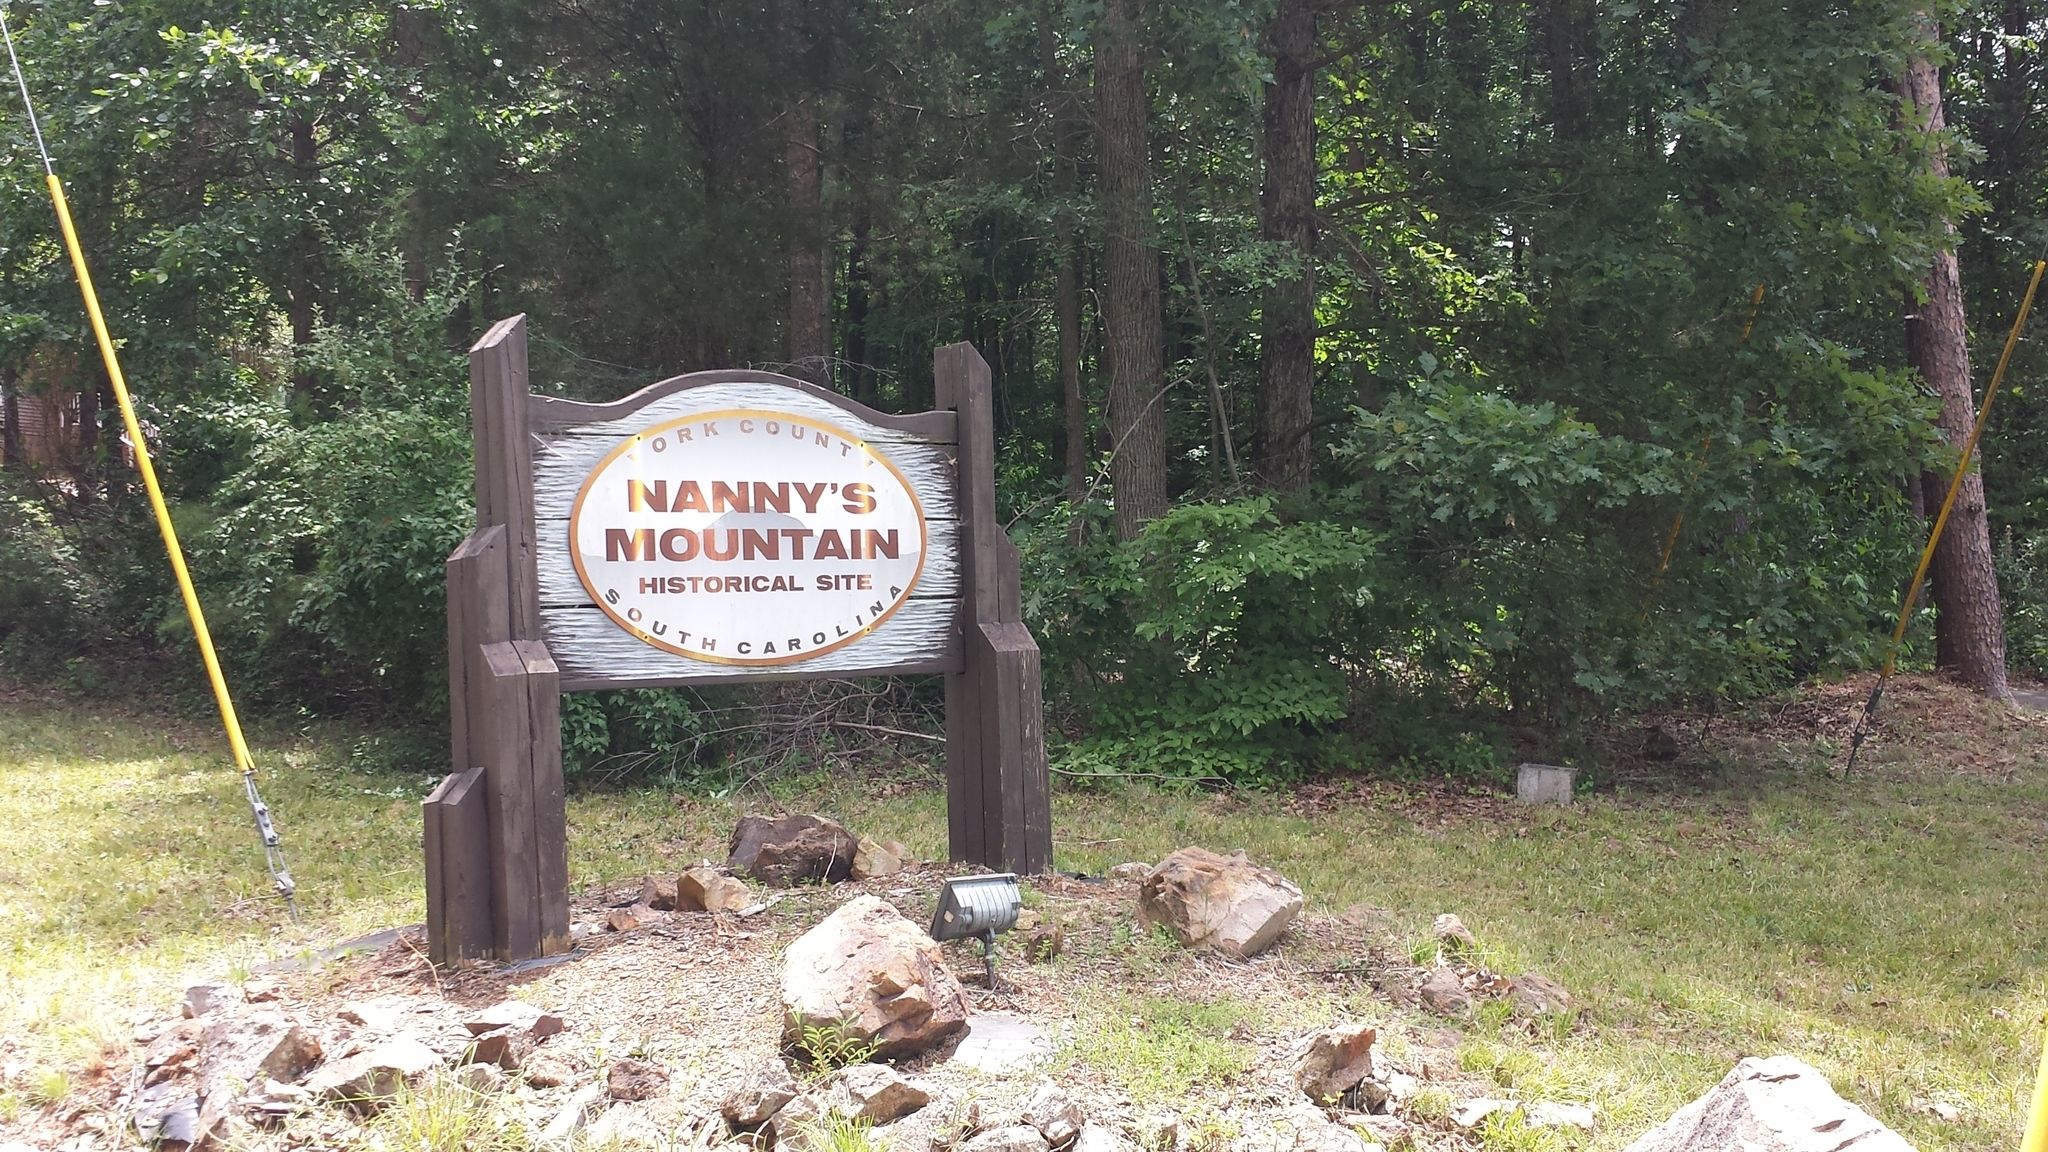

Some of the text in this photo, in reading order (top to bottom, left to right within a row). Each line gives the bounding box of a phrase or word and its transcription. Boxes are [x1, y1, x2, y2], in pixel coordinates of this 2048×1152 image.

[627, 419, 875, 468] ORK COUNT
[627, 479, 877, 514] NANNY'S
[605, 528, 899, 562] MOUNTAIN
[638, 574, 873, 594] HISTORICAL SITE
[604, 584, 902, 655] SOUTH CAROLINA
